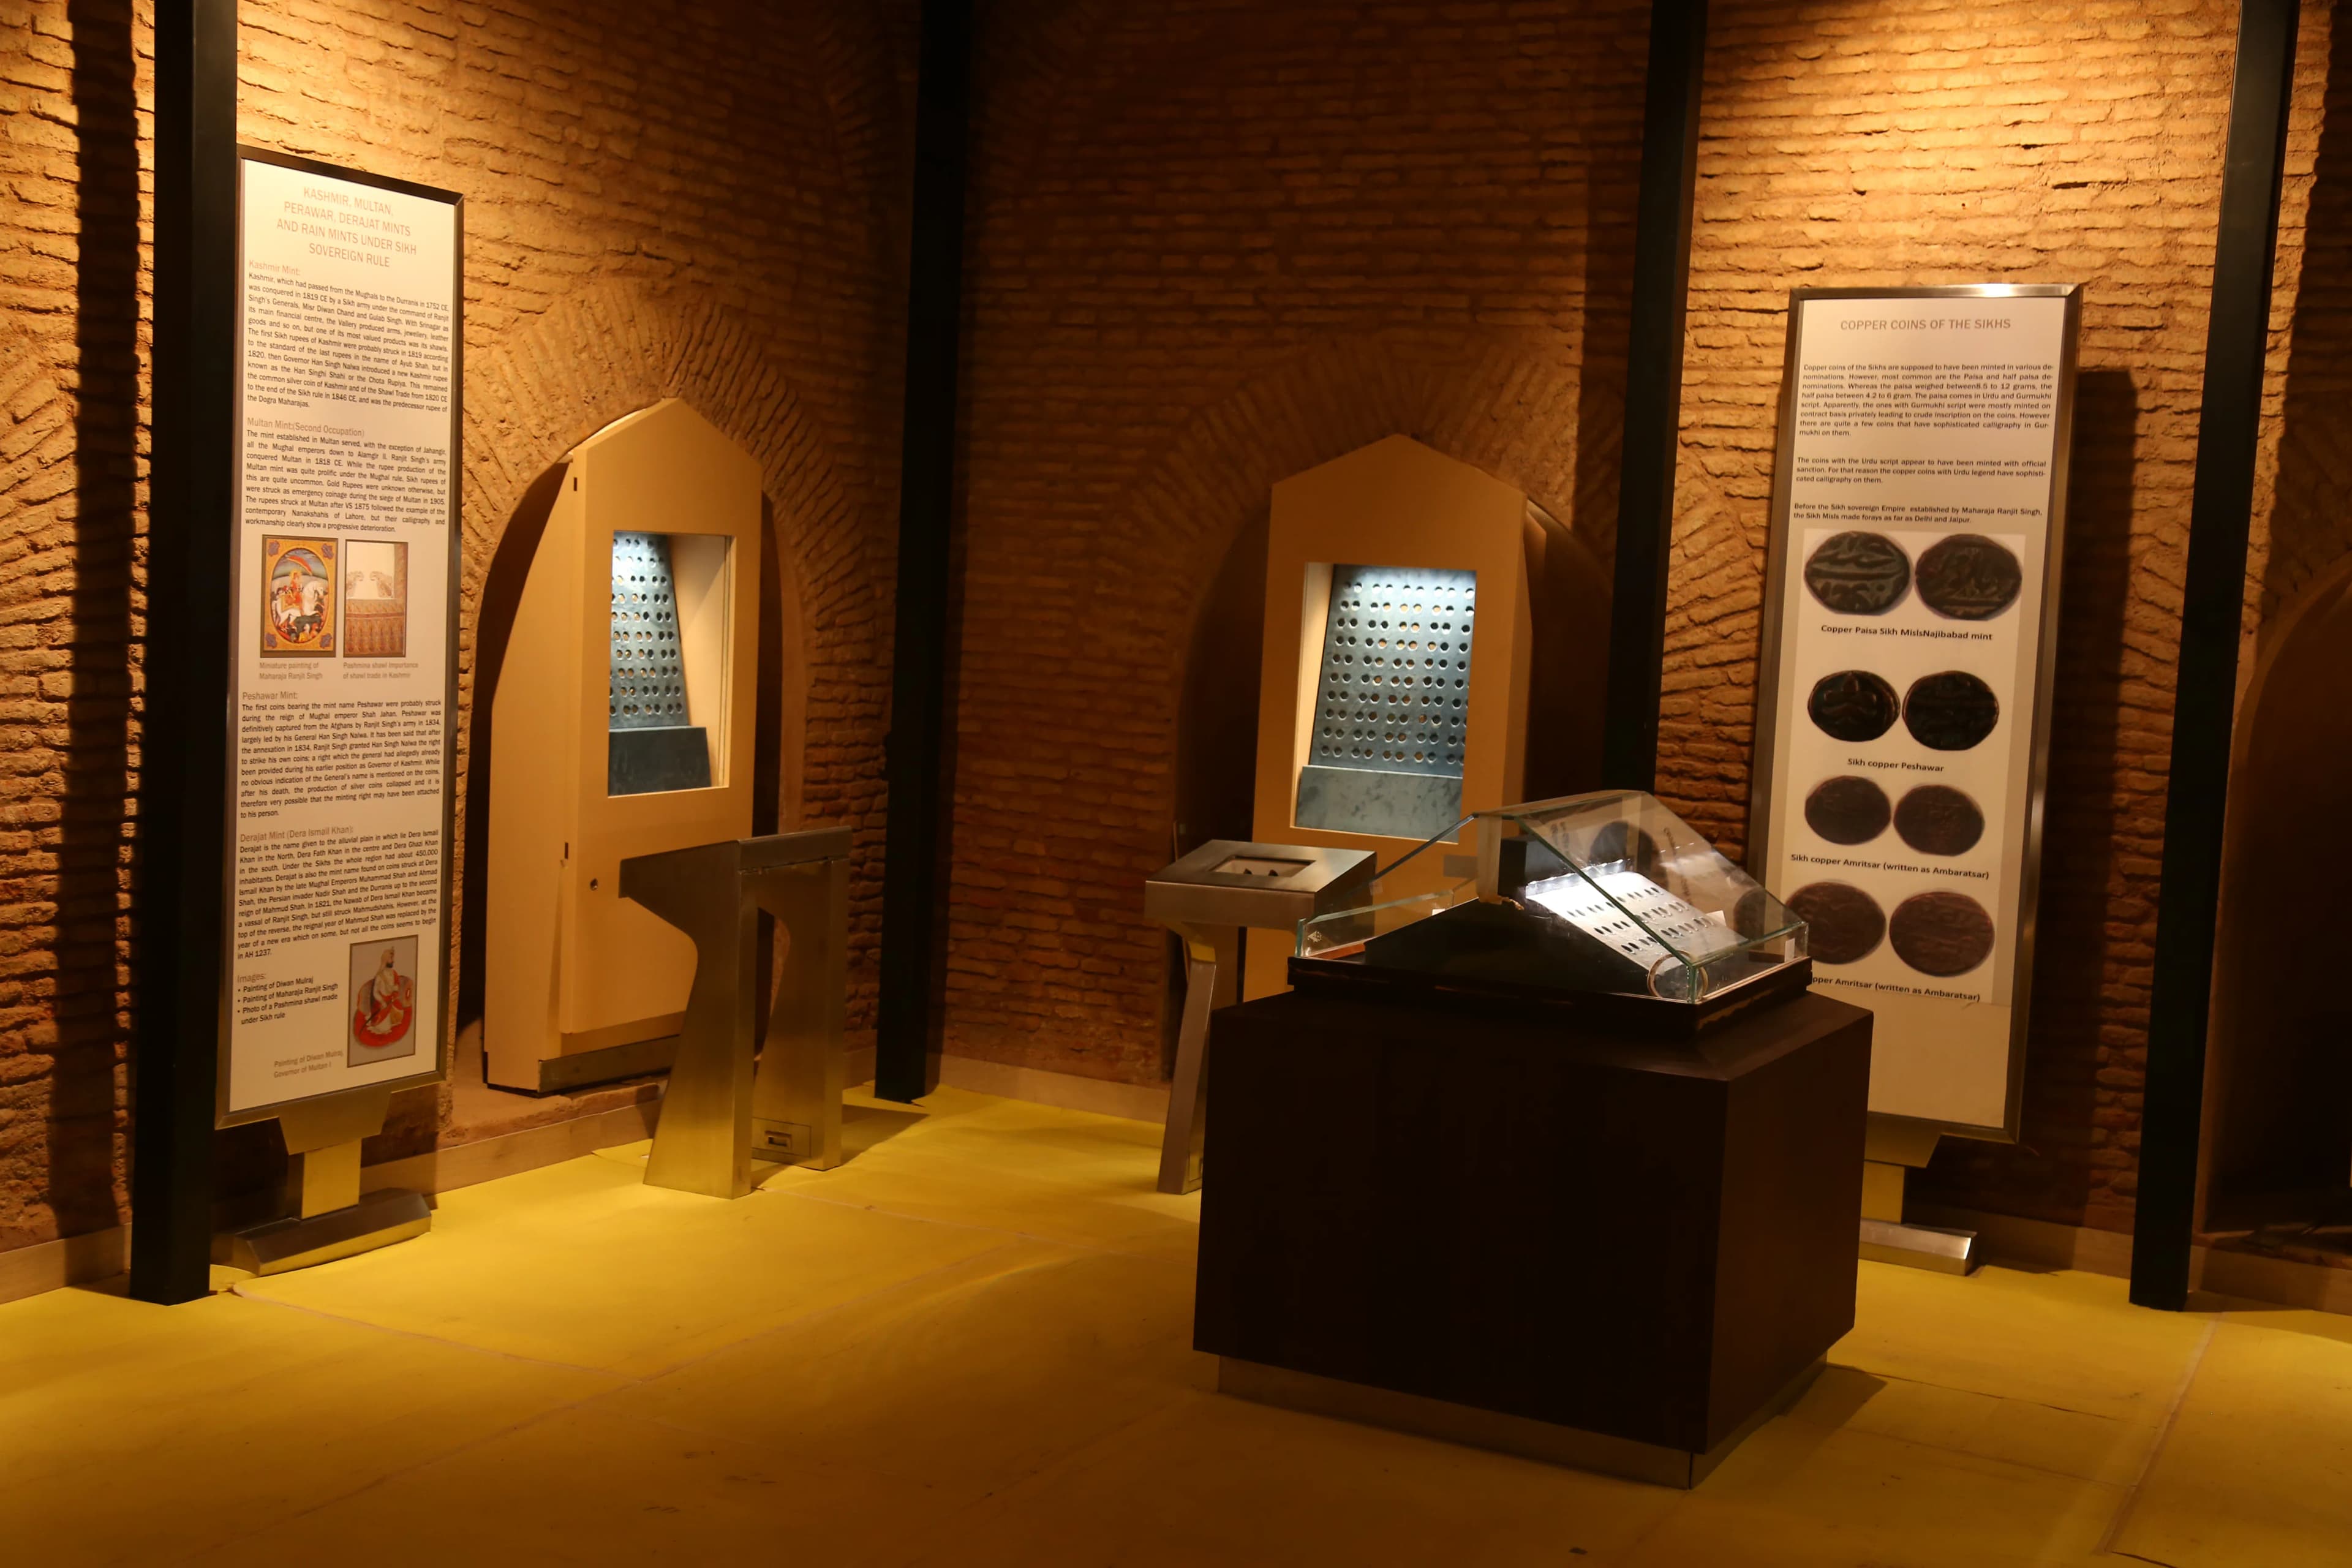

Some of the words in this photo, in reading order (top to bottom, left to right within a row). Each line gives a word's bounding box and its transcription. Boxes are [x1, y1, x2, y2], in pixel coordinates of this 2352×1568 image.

[303, 186, 352, 207] KASHMIR,
[284, 200, 336, 222] PERAWAR,
[339, 211, 380, 230] DERAJAT
[382, 221, 411, 237] MINTS
[276, 217, 299, 232] AND
[301, 222, 325, 238] RAIN
[328, 227, 358, 244] MINTS
[360, 234, 393, 251] UNDER
[394, 241, 417, 255] SIKH
[309, 242, 363, 263] SOVEREIGN
[366, 252, 390, 268] RULE
[248, 259, 281, 273] Kashmir
[281, 264, 300, 276] Mint:
[1840, 320, 1887, 330] COPPER
[1890, 319, 1926, 330] COINS
[1929, 318, 1945, 330] OF
[1948, 318, 1970, 329] THE
[1974, 318, 2011, 329] SIKHS
[258, 394, 277, 405] Dogra
[247, 417, 273, 428] Multan
[246, 429, 258, 437] The
[276, 433, 310, 443] established
[319, 436, 340, 445] Multan
[1815, 475, 1852, 484] calligraphy
[1861, 513, 1882, 522] forays
[1961, 507, 1995, 515] Maharaja
[1997, 507, 2018, 516] Ranjit
[1820, 625, 1852, 634] Copper
[1855, 626, 1877, 635] Paisa
[1879, 627, 1898, 636] Sikh
[242, 691, 279, 701] Peshawar
[279, 690, 298, 699] Mint:
[400, 699, 423, 708] probably
[1847, 758, 1866, 766] Sikh
[1867, 761, 1899, 769] copper
[1901, 761, 1944, 772] Peshawar
[239, 832, 267, 843] Derajat
[268, 831, 285, 840] Mint
[1810, 857, 1841, 865] copper
[1842, 858, 1881, 869] Amritsar
[1882, 862, 1918, 872] (written
[1932, 867, 1989, 880] Ambaratsar)
[236, 973, 266, 984] Images:
[242, 994, 268, 1003] Painting
[275, 988, 303, 998] Maharaja
[304, 985, 322, 994] Ranjit
[322, 982, 338, 992] Singh
[243, 983, 268, 993] Painting
[1834, 978, 1872, 989] Amritsar
[1874, 982, 1910, 993] (written
[1923, 988, 1980, 1003] Ambaratsar)
[242, 1006, 260, 1014] Photo
[273, 999, 303, 1009] Pashmina
[303, 995, 321, 1005] shawl
[321, 993, 338, 1001] made
[241, 1016, 258, 1025] under
[259, 1013, 273, 1022] Sikh
